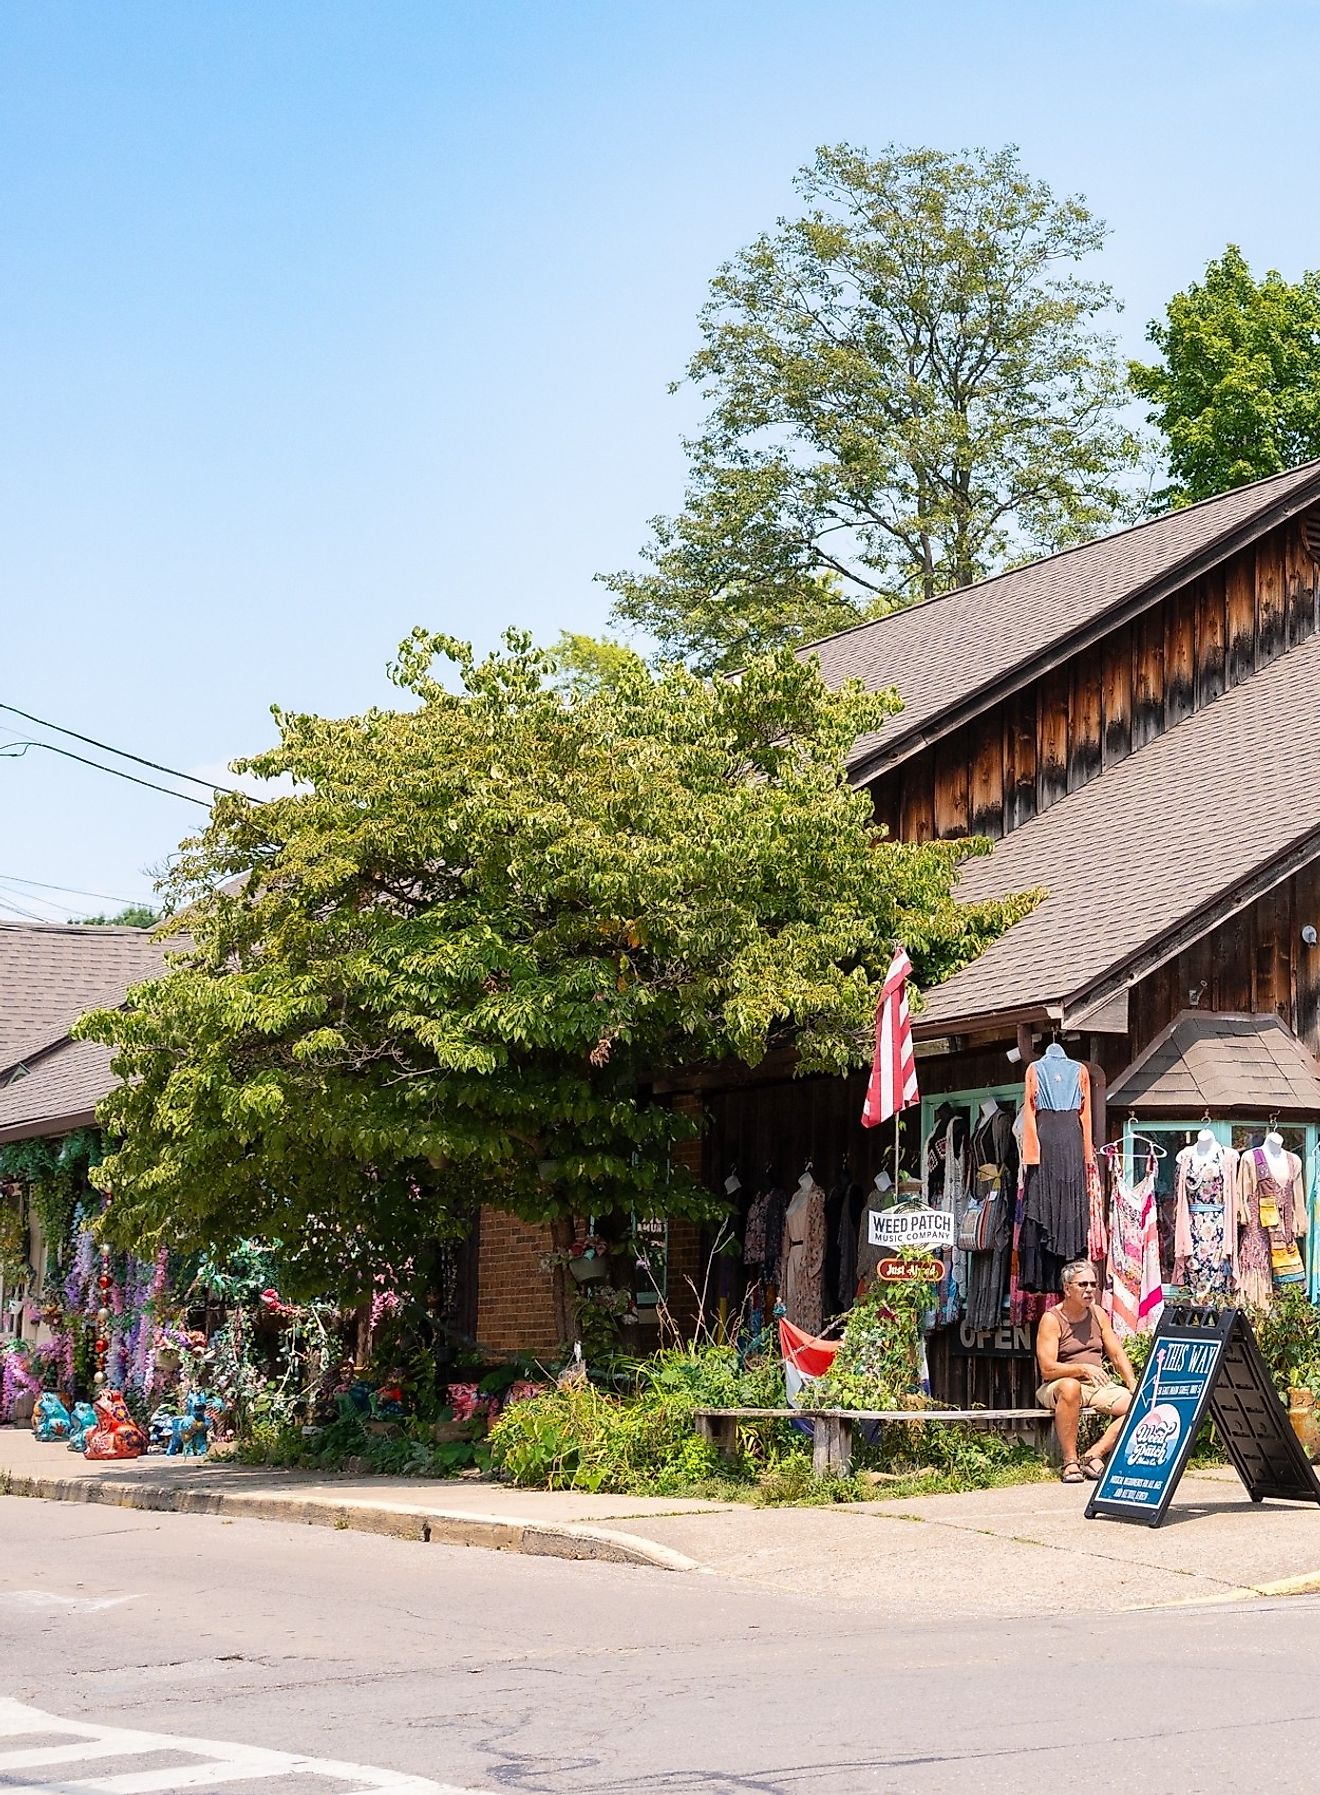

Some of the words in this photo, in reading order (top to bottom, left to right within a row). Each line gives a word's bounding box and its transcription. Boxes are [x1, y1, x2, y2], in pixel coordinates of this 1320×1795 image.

[873, 1216, 908, 1234] WEED
[911, 1214, 951, 1232] PATCH
[874, 1232, 903, 1242] MUSIC
[906, 1231, 950, 1241] COMPANY
[886, 1264, 905, 1276] Just
[1162, 1343, 1189, 1372] THIS
[1188, 1344, 1217, 1374] WAY
[1136, 1420, 1177, 1444] Weed
[1127, 1442, 1167, 1466] Patch
